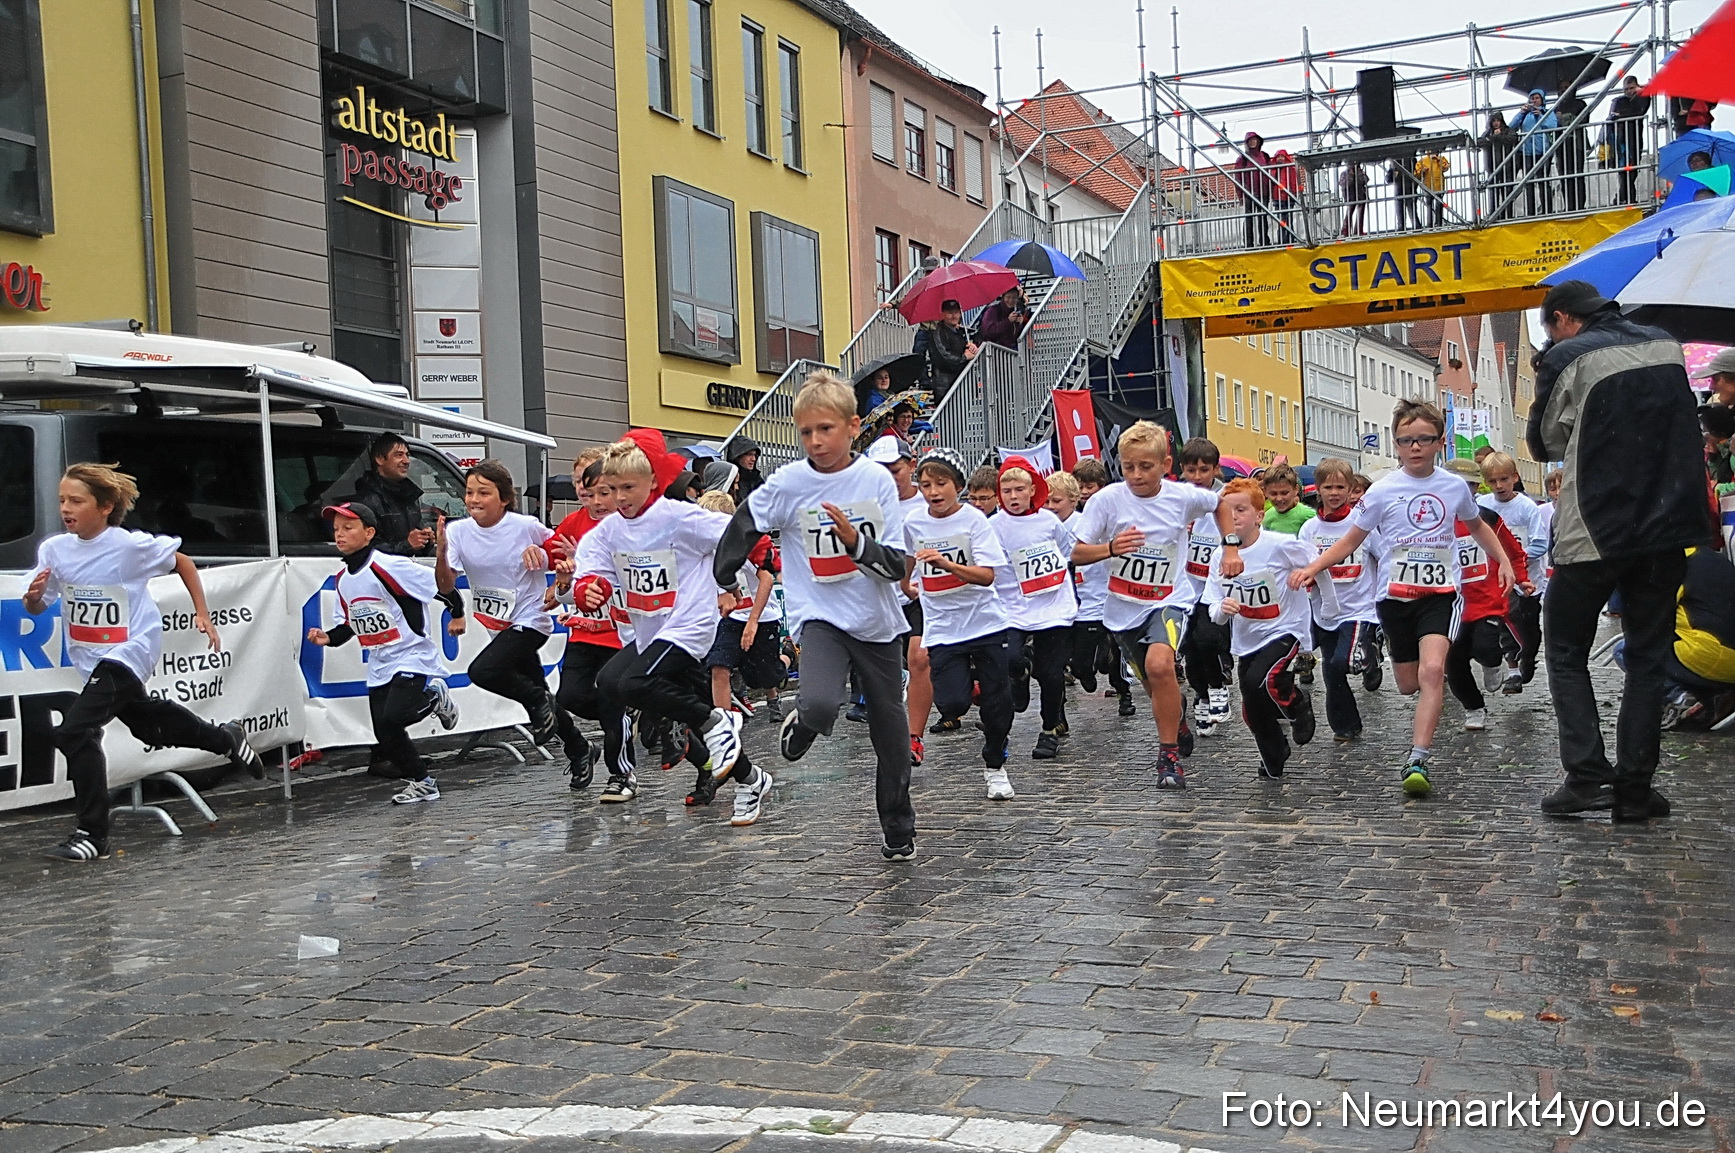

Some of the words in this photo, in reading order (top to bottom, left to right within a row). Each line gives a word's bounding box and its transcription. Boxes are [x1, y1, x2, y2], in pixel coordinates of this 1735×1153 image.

[338, 86, 461, 162] altstadt
[341, 143, 463, 210] passage
[1309, 242, 1471, 294] START
[1502, 254, 1563, 267] Neumarkter
[1186, 288, 1239, 297] Neumarkter
[1240, 282, 1281, 294] Stadtlauf
[706, 382, 751, 410] GERRY
[1020, 553, 1063, 579] 7232
[1119, 555, 1170, 584] 7017
[1396, 562, 1446, 585] 7133
[623, 568, 669, 593] 7234
[1127, 585, 1155, 598] Lukas
[473, 597, 509, 619] 7271
[1222, 585, 1270, 607] 7170
[67, 600, 120, 626] 7270
[352, 613, 390, 635] 7238
[163, 650, 232, 676] Herzen
[175, 675, 223, 701] Stadt
